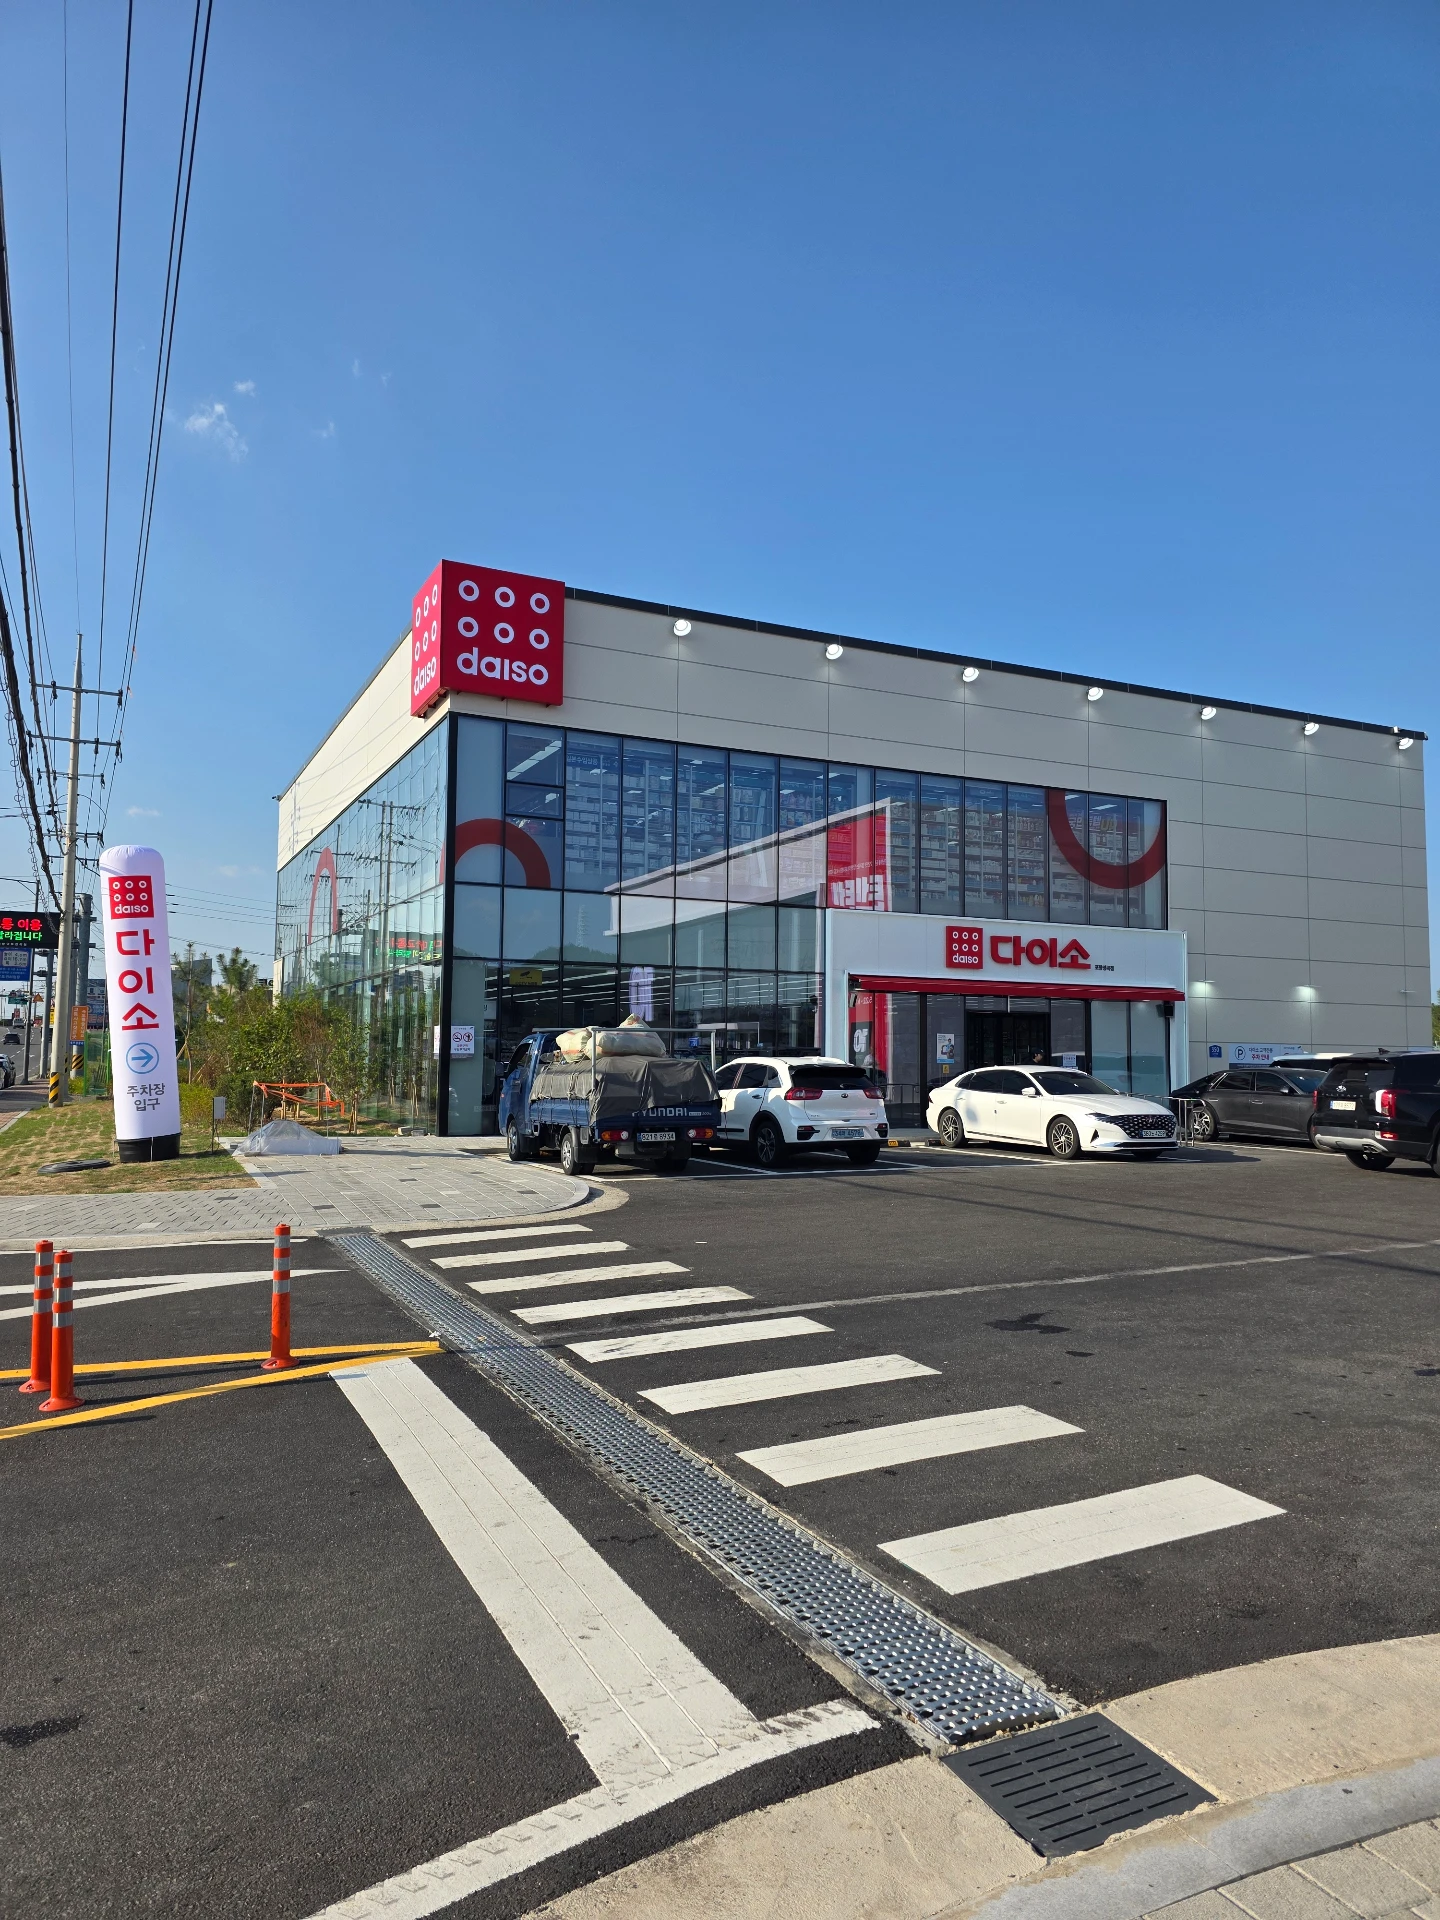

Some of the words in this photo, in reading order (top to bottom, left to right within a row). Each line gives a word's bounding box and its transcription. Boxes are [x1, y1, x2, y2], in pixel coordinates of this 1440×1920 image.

[456, 646, 549, 686] daiso
[413, 656, 437, 697] daiso
[114, 903, 149, 914] daiso
[17, 918, 43, 931] 이용
[952, 953, 979, 964] daiso
[990, 935, 1092, 969] 다이소
[115, 929, 160, 1031] 다이소
[126, 1083, 165, 1097] 주차장
[134, 1098, 160, 1112] 입구
